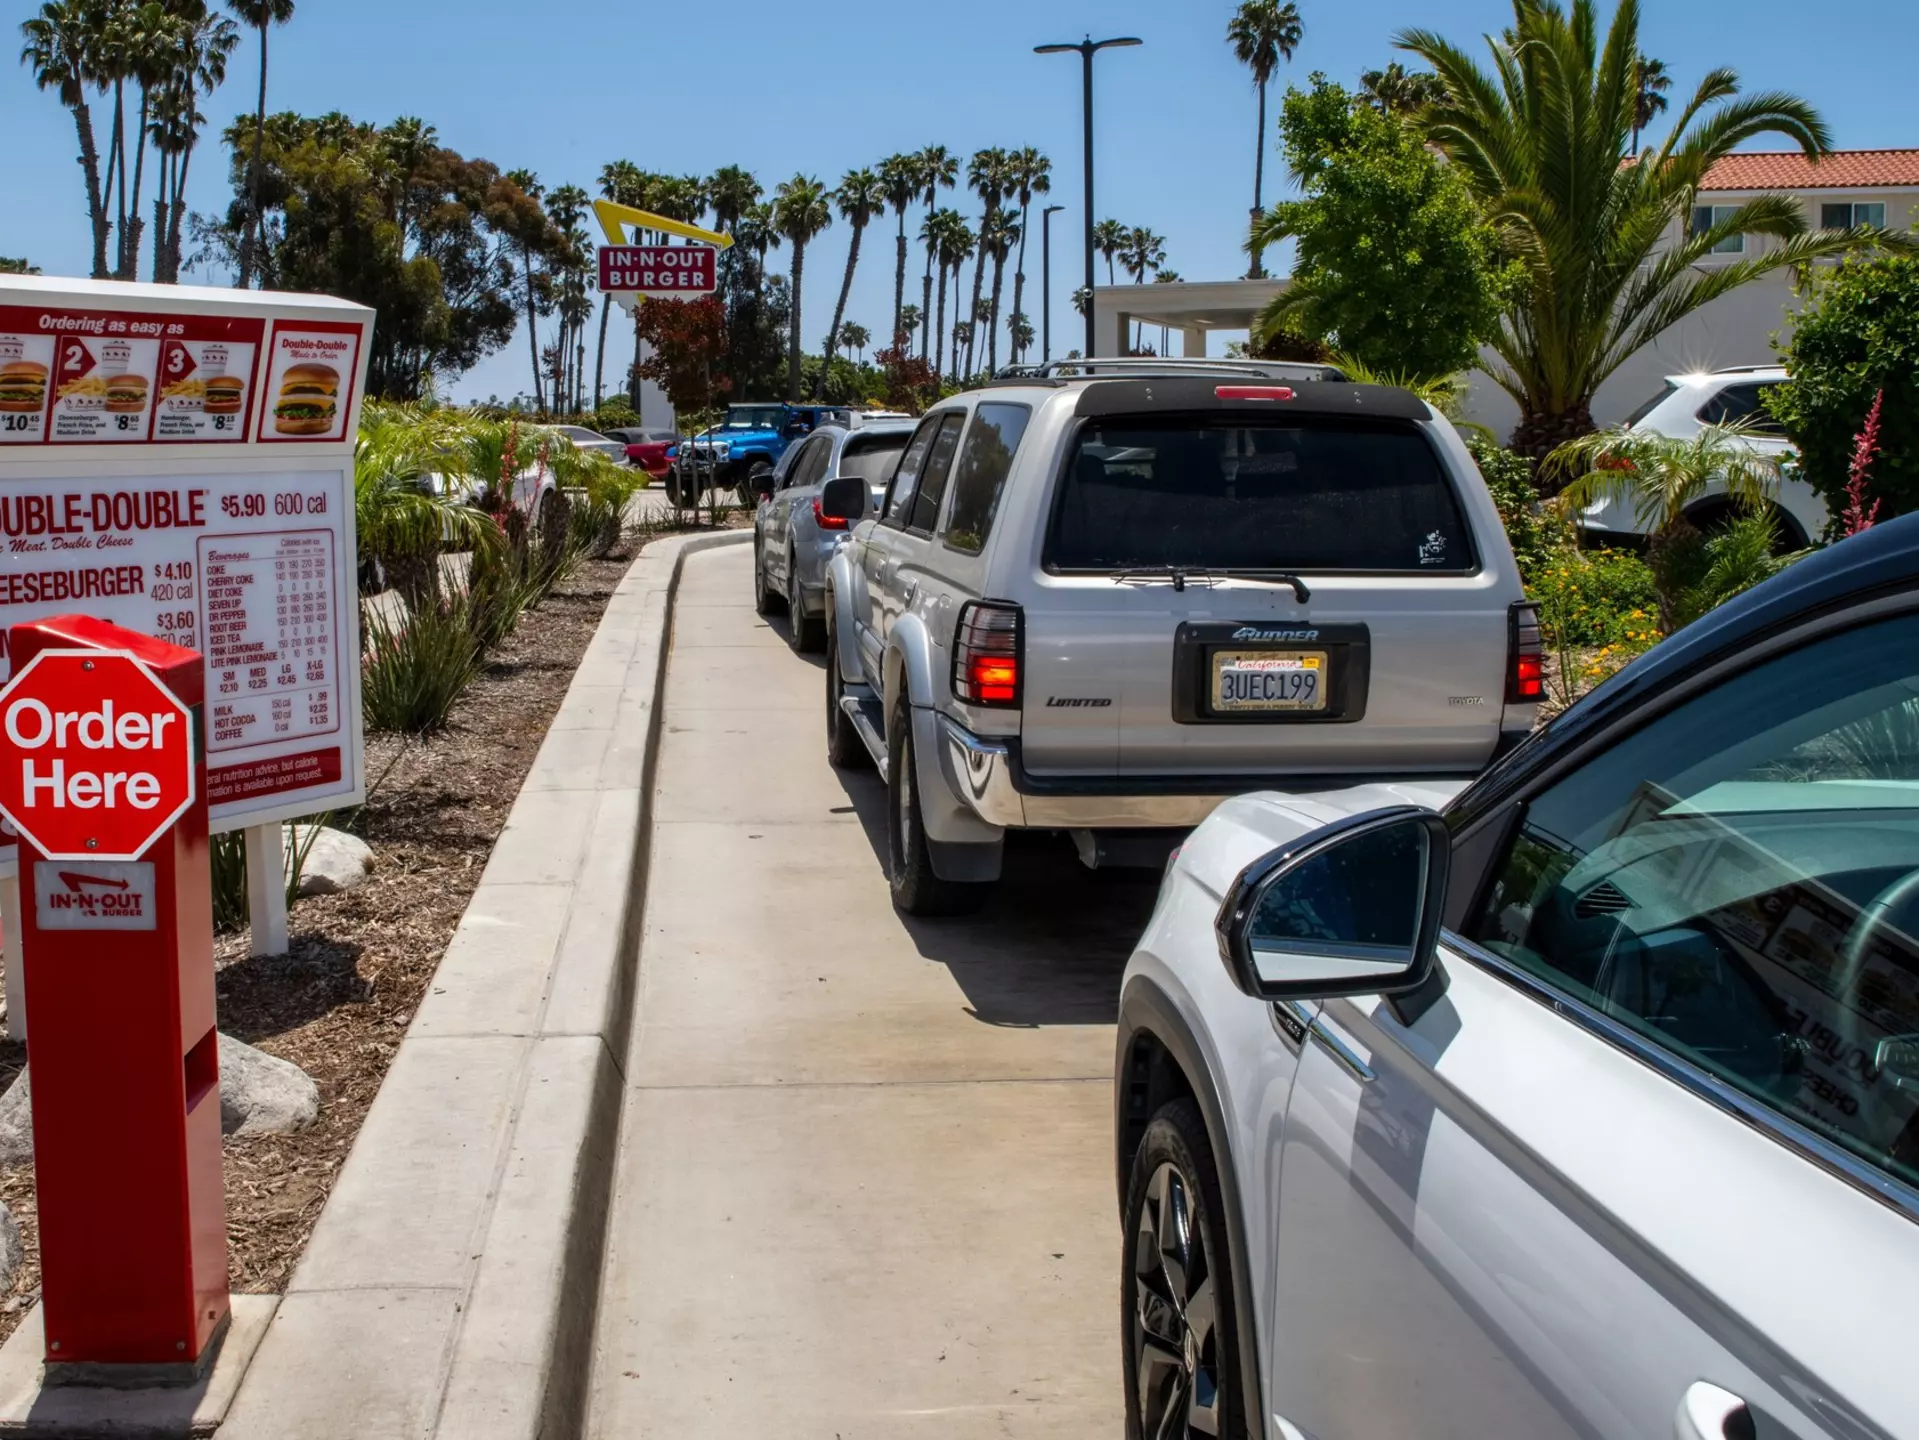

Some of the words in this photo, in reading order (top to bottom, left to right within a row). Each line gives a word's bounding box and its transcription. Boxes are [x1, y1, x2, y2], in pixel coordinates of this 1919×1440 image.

[609, 271, 705, 287] BURGER
[39, 314, 106, 334] Ordering
[108, 320, 126, 332] as
[130, 322, 164, 337] easy
[167, 323, 185, 335] as
[282, 338, 348, 351] Double-Double
[64, 345, 83, 370] 2
[168, 348, 185, 373] 3
[311, 351, 318, 359] to
[319, 350, 338, 360] Order
[0, 489, 206, 536] UBLE-DOUBLE
[221, 494, 265, 518] $5.90
[274, 493, 303, 516] 600
[307, 492, 326, 513] cal
[51, 536, 92, 550] Double
[96, 534, 134, 549] Cheese
[208, 551, 250, 562] Beverages
[207, 565, 225, 575] COKE
[302, 559, 312, 568] 270
[207, 577, 234, 587] CHERRY
[236, 575, 254, 585] COKE
[208, 588, 223, 599] DIET
[225, 587, 243, 597] COKE
[279, 584, 283, 592] 0
[292, 582, 296, 591] 0
[305, 582, 310, 590] 0
[318, 580, 323, 589] 0
[151, 584, 173, 601] 420
[176, 582, 193, 599] cal
[208, 600, 231, 610] SEVEN
[232, 599, 241, 609] UP
[157, 611, 194, 631] $3.60
[209, 612, 219, 622] DR
[220, 610, 246, 621] PEPPER
[210, 623, 228, 633] ROOT
[229, 621, 247, 631] BEER
[290, 616, 300, 625] 210
[304, 614, 314, 624] 300
[316, 613, 327, 622] 400
[179, 630, 196, 648] cal
[210, 635, 225, 645] ICED
[227, 633, 241, 643] TEA
[280, 629, 284, 637] 0
[293, 627, 298, 636] 0
[307, 626, 311, 635] 0
[320, 625, 324, 633] 0
[211, 647, 227, 656] PINK
[228, 642, 264, 654] LEMONADE
[291, 638, 301, 647] 210
[304, 637, 315, 646] 300
[317, 635, 328, 644] 400
[211, 658, 225, 668] LITE
[226, 657, 242, 666] PINK
[243, 652, 279, 665] LEMONADE
[281, 651, 285, 660] 5
[307, 647, 313, 656] 15
[306, 660, 323, 670] X-LG
[1237, 659, 1302, 671] California
[223, 671, 235, 682] SM
[250, 667, 266, 677] MED
[281, 663, 291, 673] LG
[220, 683, 239, 693] $2.10
[248, 679, 267, 689] $2.25
[277, 675, 296, 685] $2.45
[1222, 673, 1317, 701] 3UEC199
[214, 705, 233, 716] MILK
[283, 697, 291, 706] cal
[1448, 697, 1484, 705] TOYOTA
[5, 698, 175, 749] Order
[214, 718, 229, 729] HOT
[231, 714, 256, 726] COCOA
[283, 709, 292, 719] cal
[309, 703, 328, 713] $2.25
[214, 728, 243, 740] COFFEE
[275, 723, 279, 732] 0
[281, 722, 289, 731] cal
[223, 768, 253, 782] nutrition
[281, 760, 294, 771] but
[295, 756, 318, 769] calorie
[22, 758, 161, 809] Here
[234, 782, 242, 793] is
[242, 776, 275, 792] available
[275, 774, 294, 787] upon
